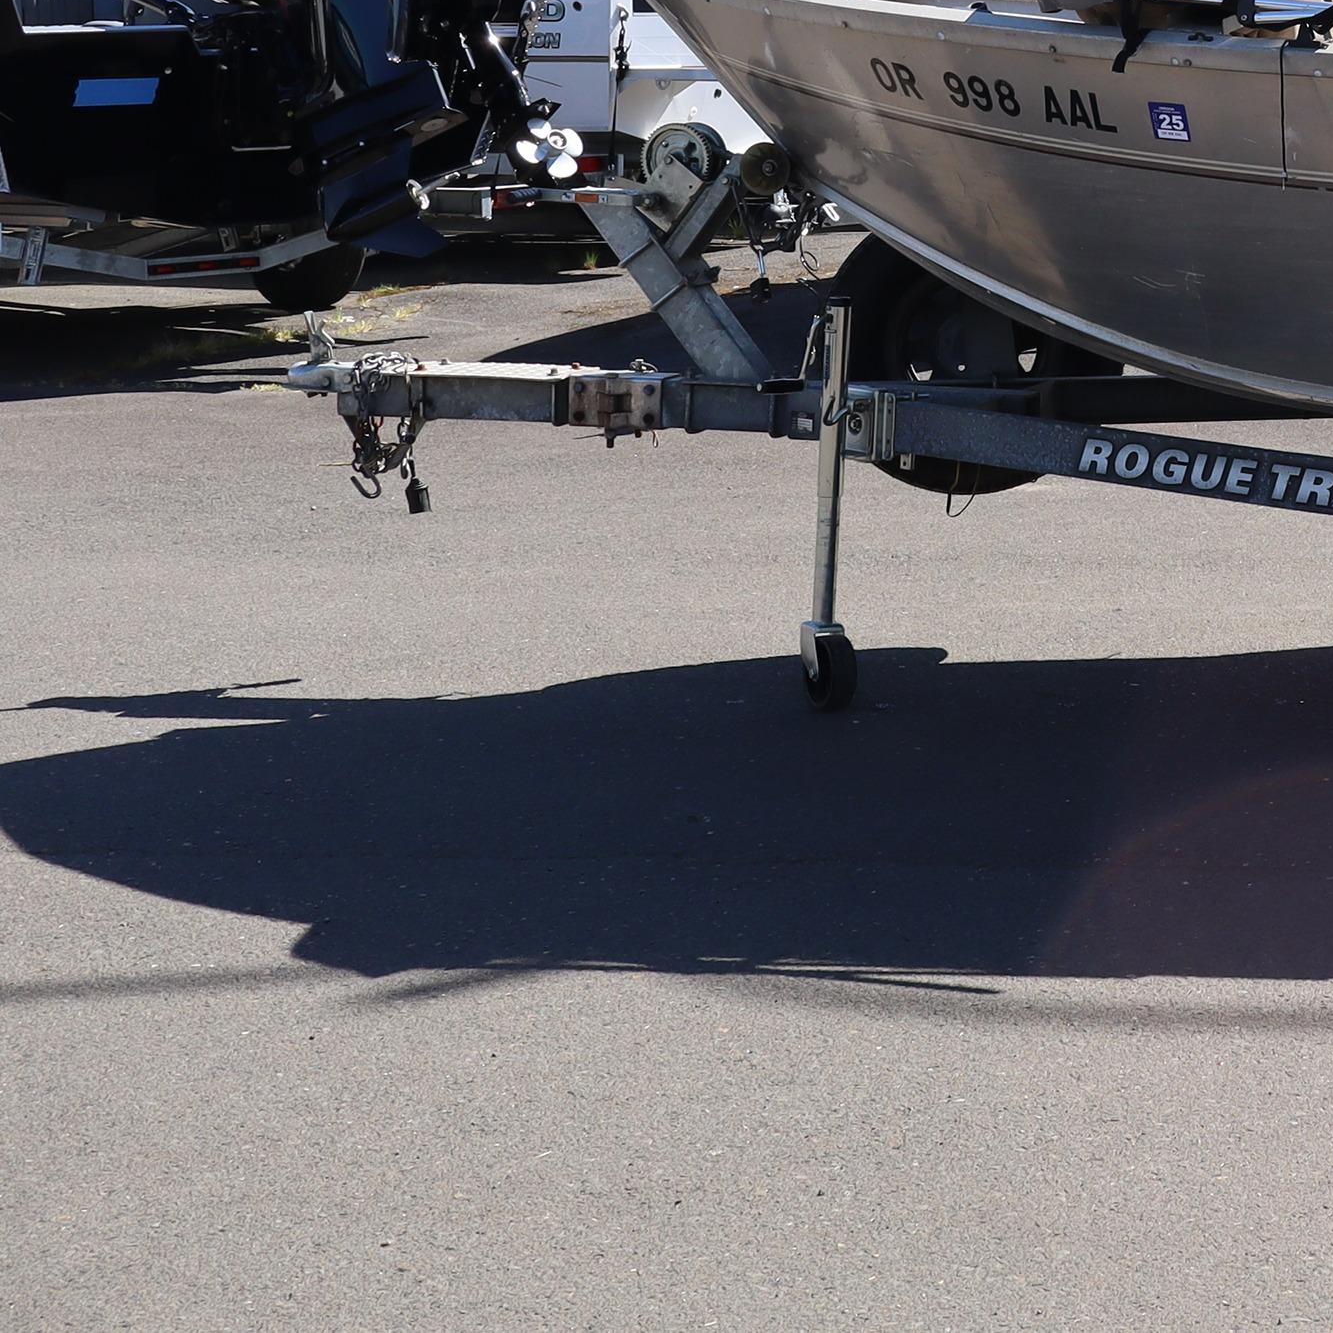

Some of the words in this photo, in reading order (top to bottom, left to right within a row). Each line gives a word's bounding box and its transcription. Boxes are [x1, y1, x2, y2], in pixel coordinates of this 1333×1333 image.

[528, 32, 561, 49] ON
[870, 58, 924, 100] OR
[943, 71, 1021, 116] 998
[1044, 85, 1118, 133] AAL
[1159, 113, 1184, 131] 25
[1078, 438, 1258, 495] ROGUE
